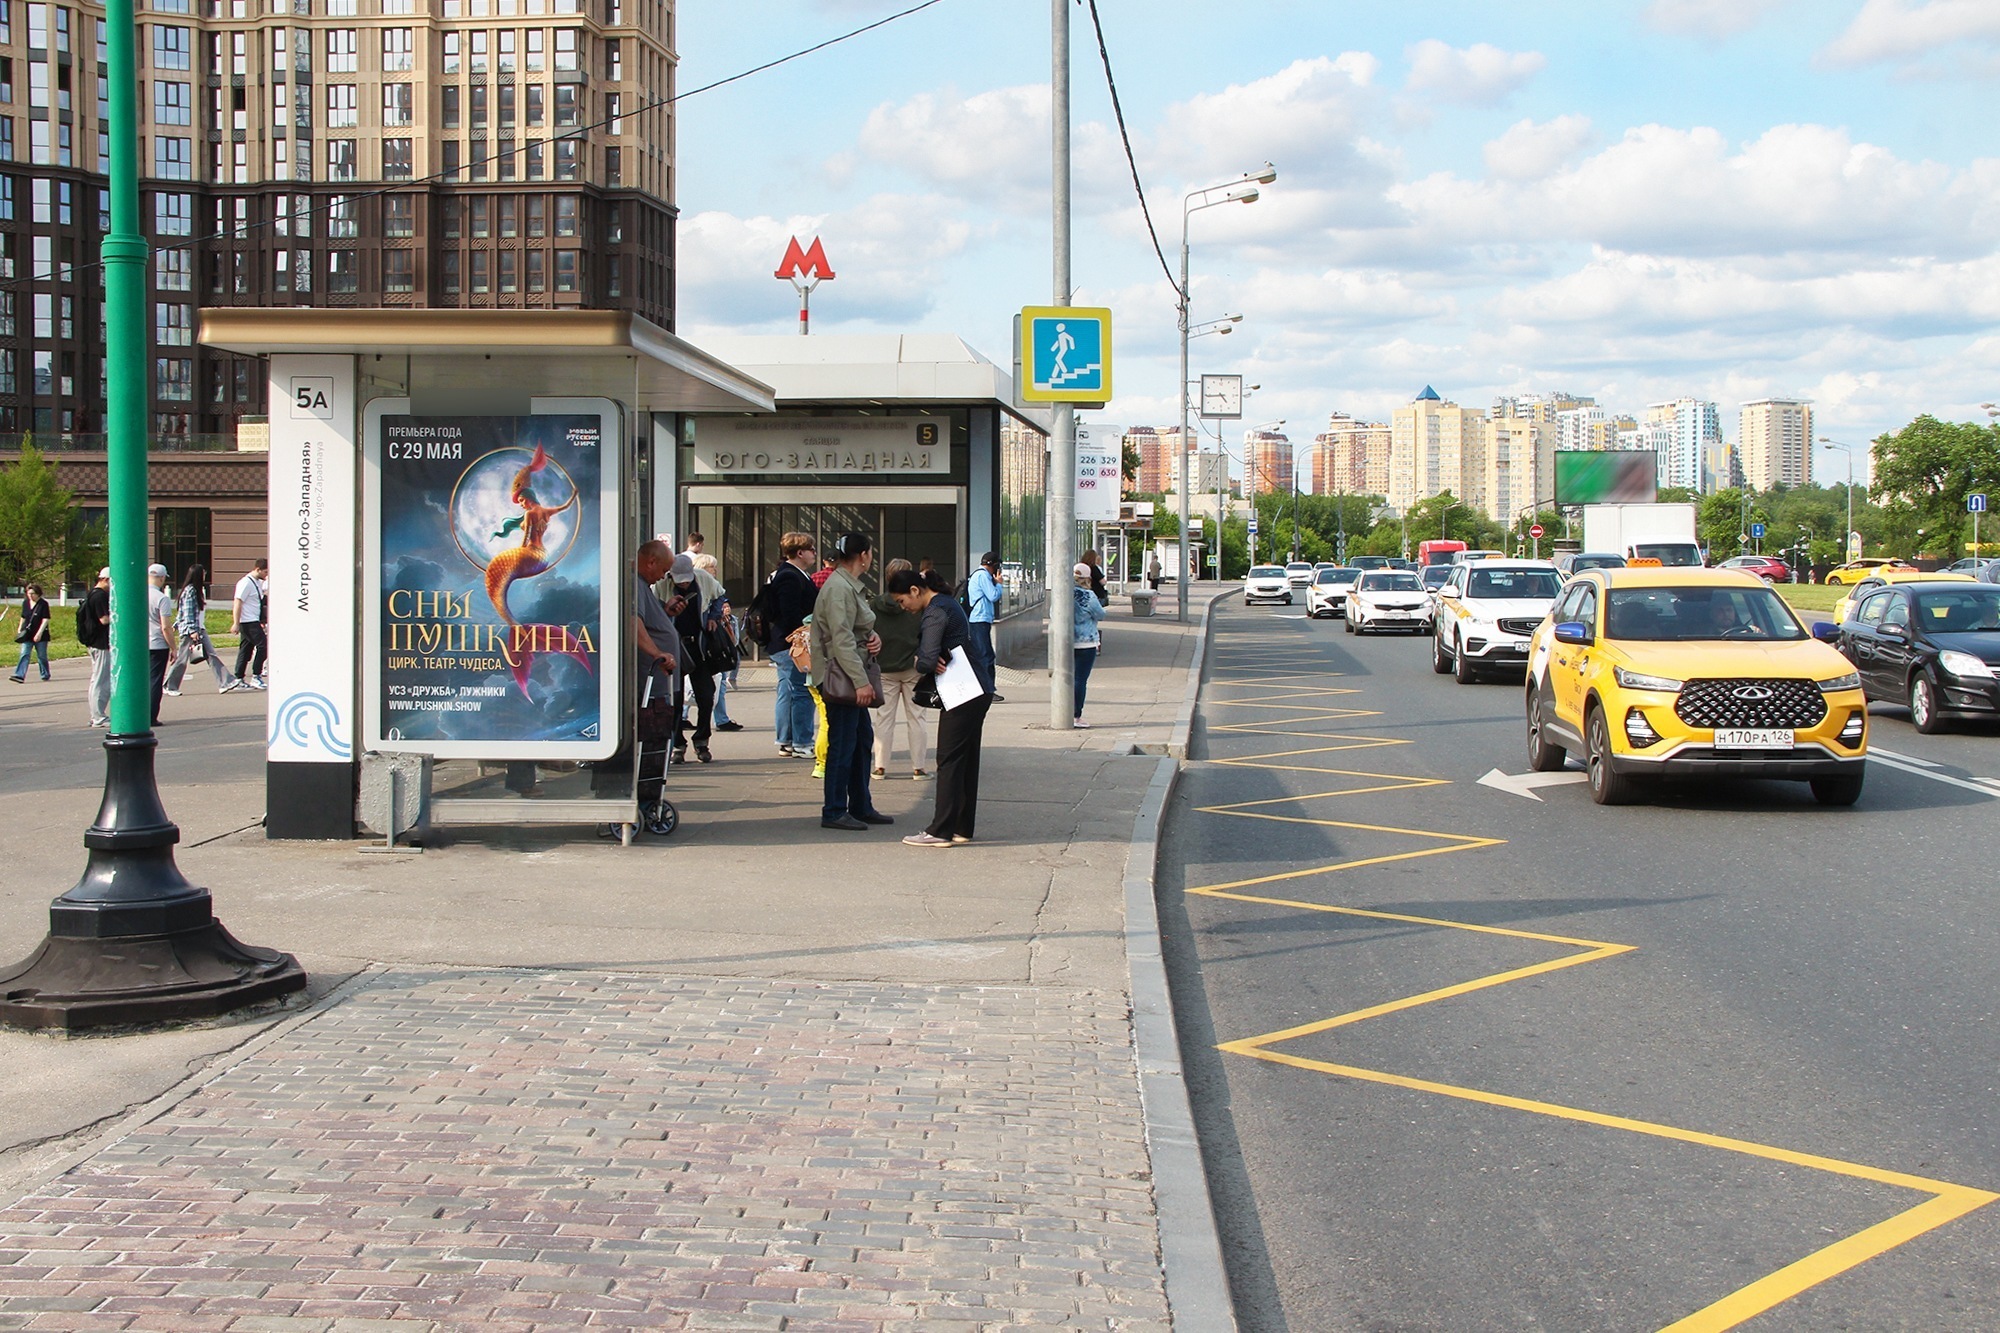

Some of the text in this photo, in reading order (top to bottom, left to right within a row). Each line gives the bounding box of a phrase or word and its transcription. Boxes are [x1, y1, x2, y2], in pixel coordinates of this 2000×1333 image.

[774, 235, 835, 280] М
[296, 387, 328, 409] 5А
[388, 426, 462, 439] ПРЕМЬЕРА ГОДА
[922, 427, 932, 440] 5
[388, 442, 462, 460] С 29 МАЯ
[714, 451, 931, 471] ЮГО-ЗАПАДНАЯ
[1080, 456, 1096, 464] 226
[1081, 468, 1116, 477] 610 630
[1080, 480, 1096, 488] 699
[314, 441, 325, 550] Metro Yugo-Zapadnaya
[297, 441, 312, 612] Метро «Юго-Западная»
[388, 589, 474, 619] СНЫ
[389, 623, 597, 668] ПУШКИНА
[388, 657, 505, 672] ЦИРК. ТЕАТР. ЧУДЕСА.
[388, 686, 506, 698] УСЗ «ДРУЖБА», ЛУЖНИКИ
[388, 700, 482, 712] WWW.PUSHKIN.SHOW
[1718, 730, 1790, 743] Н170РА 126
